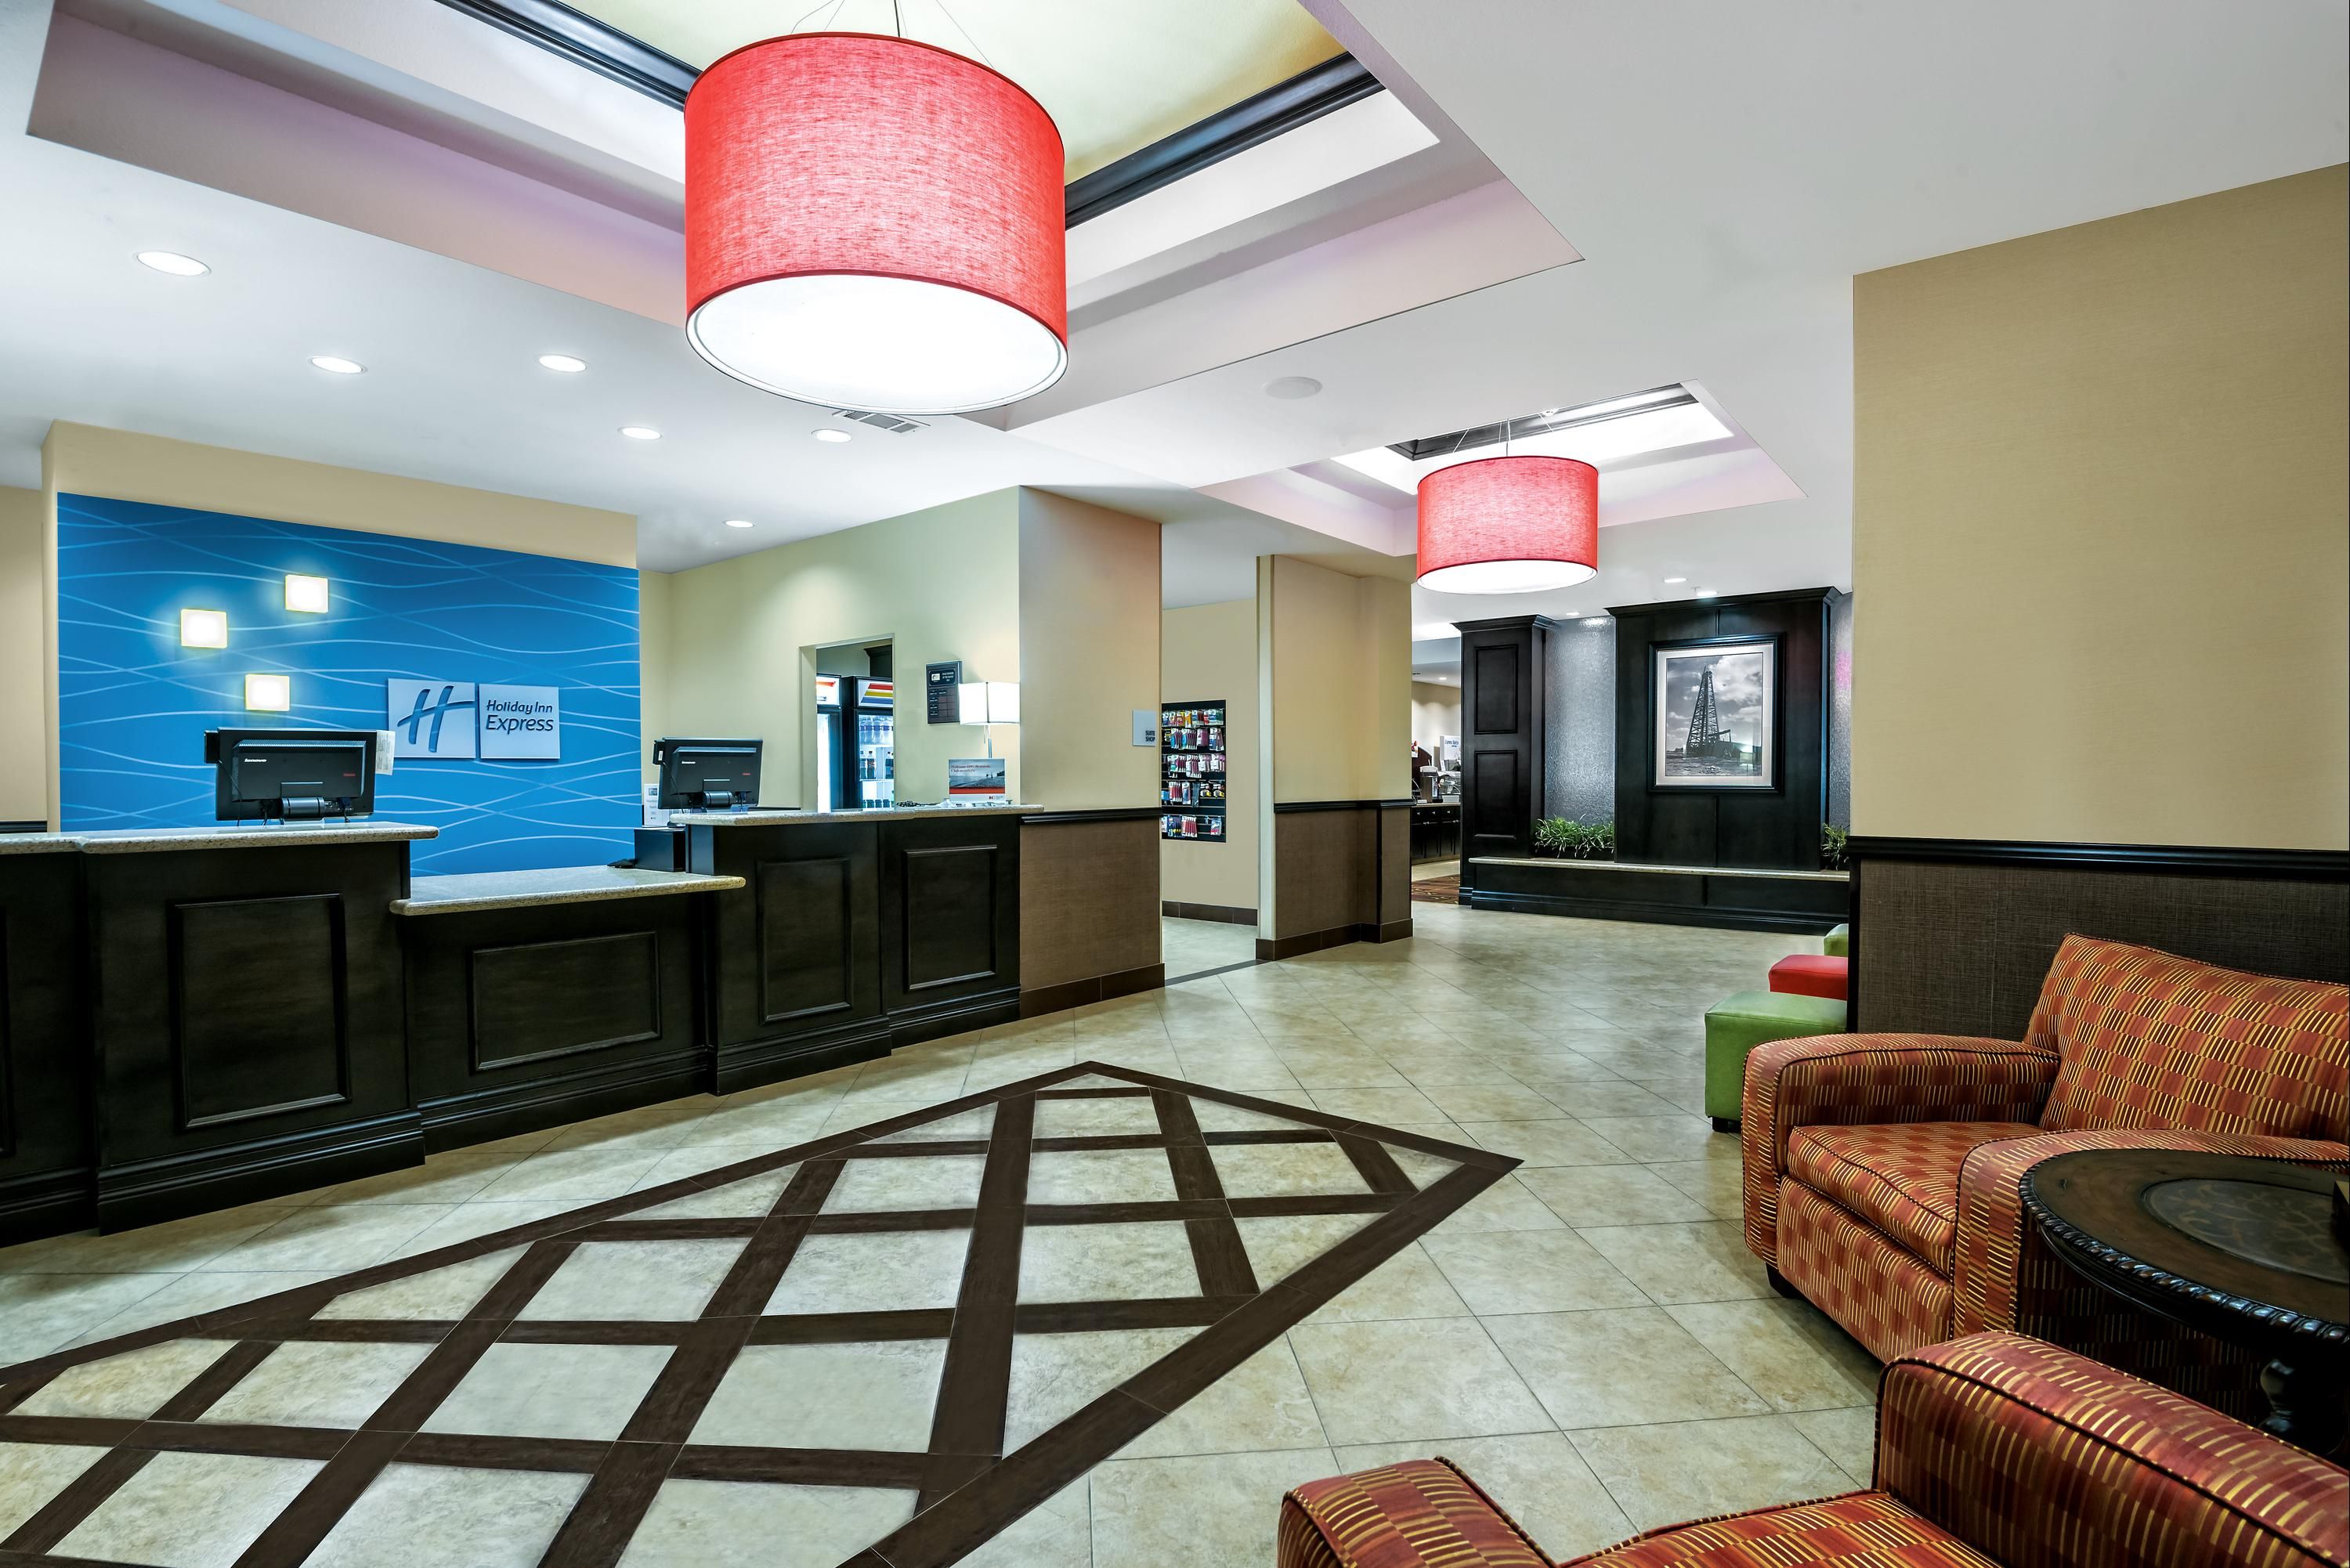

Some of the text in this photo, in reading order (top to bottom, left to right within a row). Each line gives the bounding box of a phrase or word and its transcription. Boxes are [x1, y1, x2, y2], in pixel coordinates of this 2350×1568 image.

[486, 699, 553, 714] Holiday Inn
[486, 714, 554, 735] Express
